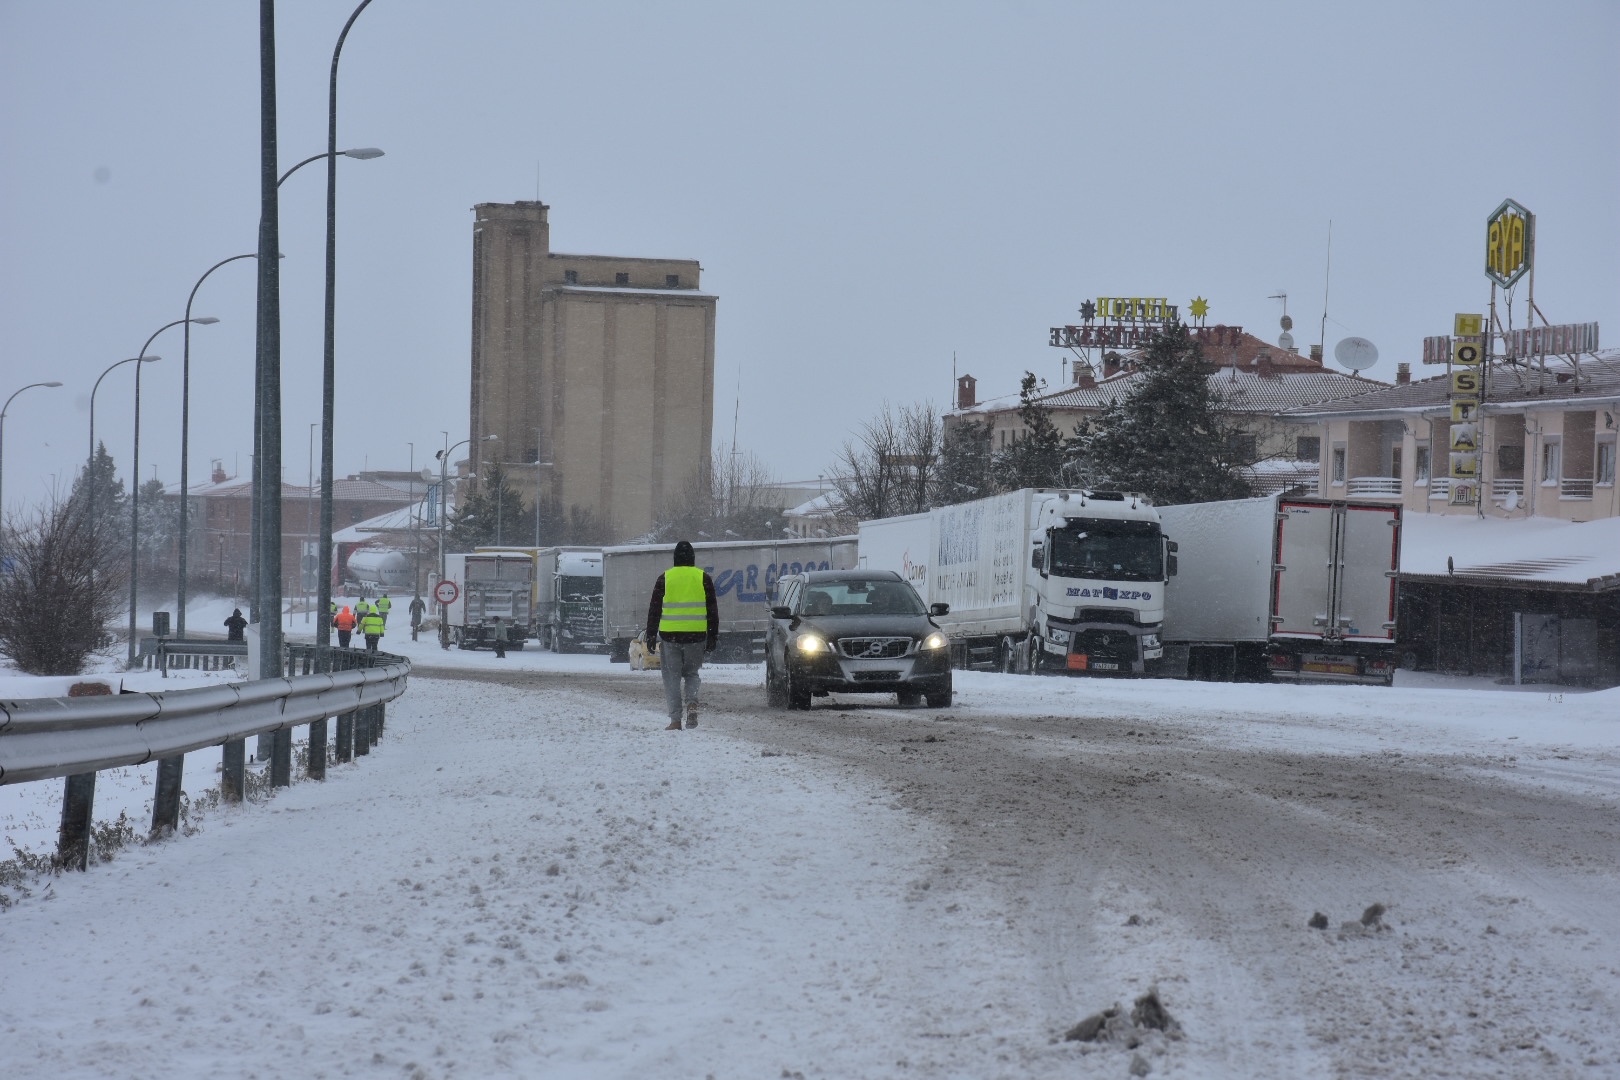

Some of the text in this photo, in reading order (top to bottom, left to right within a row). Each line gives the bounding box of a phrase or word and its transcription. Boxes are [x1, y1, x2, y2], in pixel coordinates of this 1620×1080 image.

[1095, 297, 1173, 318] HOTEL
[1064, 325, 1243, 348] RESTANTE
[1423, 336, 1447, 363] BAR
[1506, 323, 1594, 358] CAFETERIA
[1454, 317, 1479, 475] HOSTAL
